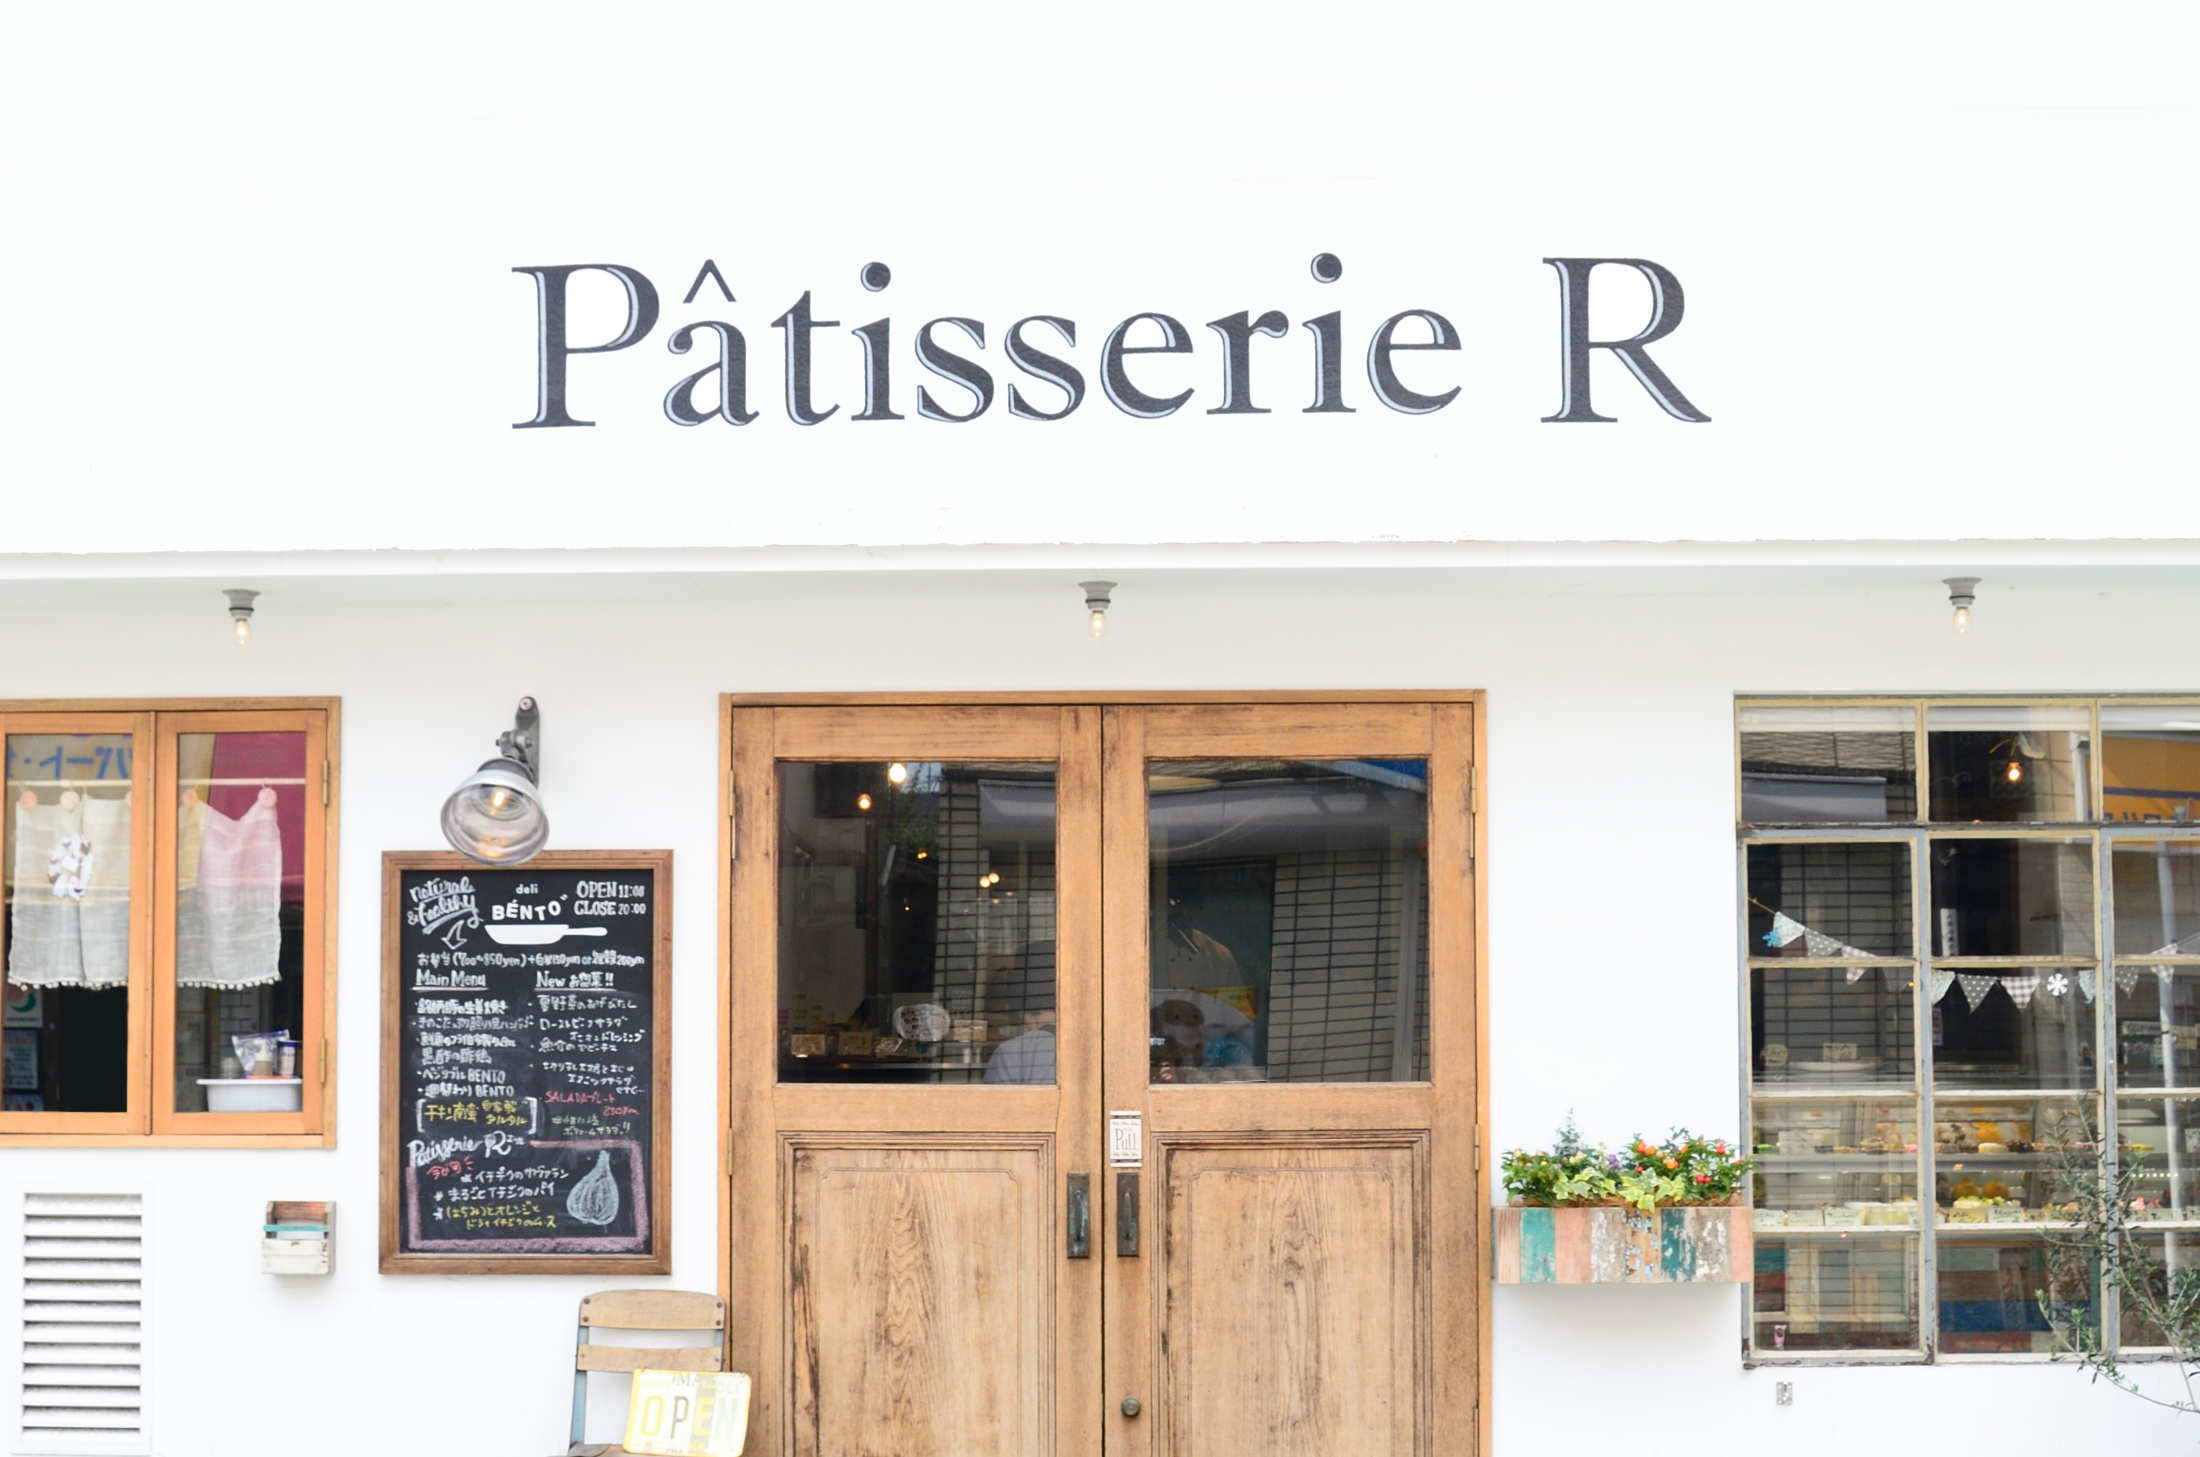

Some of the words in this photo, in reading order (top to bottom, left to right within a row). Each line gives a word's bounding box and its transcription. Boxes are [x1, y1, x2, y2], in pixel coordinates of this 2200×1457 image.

[511, 251, 1462, 429] Pâtisserie
[1540, 256, 1711, 425] R
[576, 880, 617, 898] OPEN
[573, 900, 617, 916] CLOSE
[416, 968, 450, 986] Main
[451, 969, 486, 987] Menu
[536, 970, 566, 988] New
[467, 1068, 506, 1084] BENTO
[475, 1084, 515, 1098] BENTO
